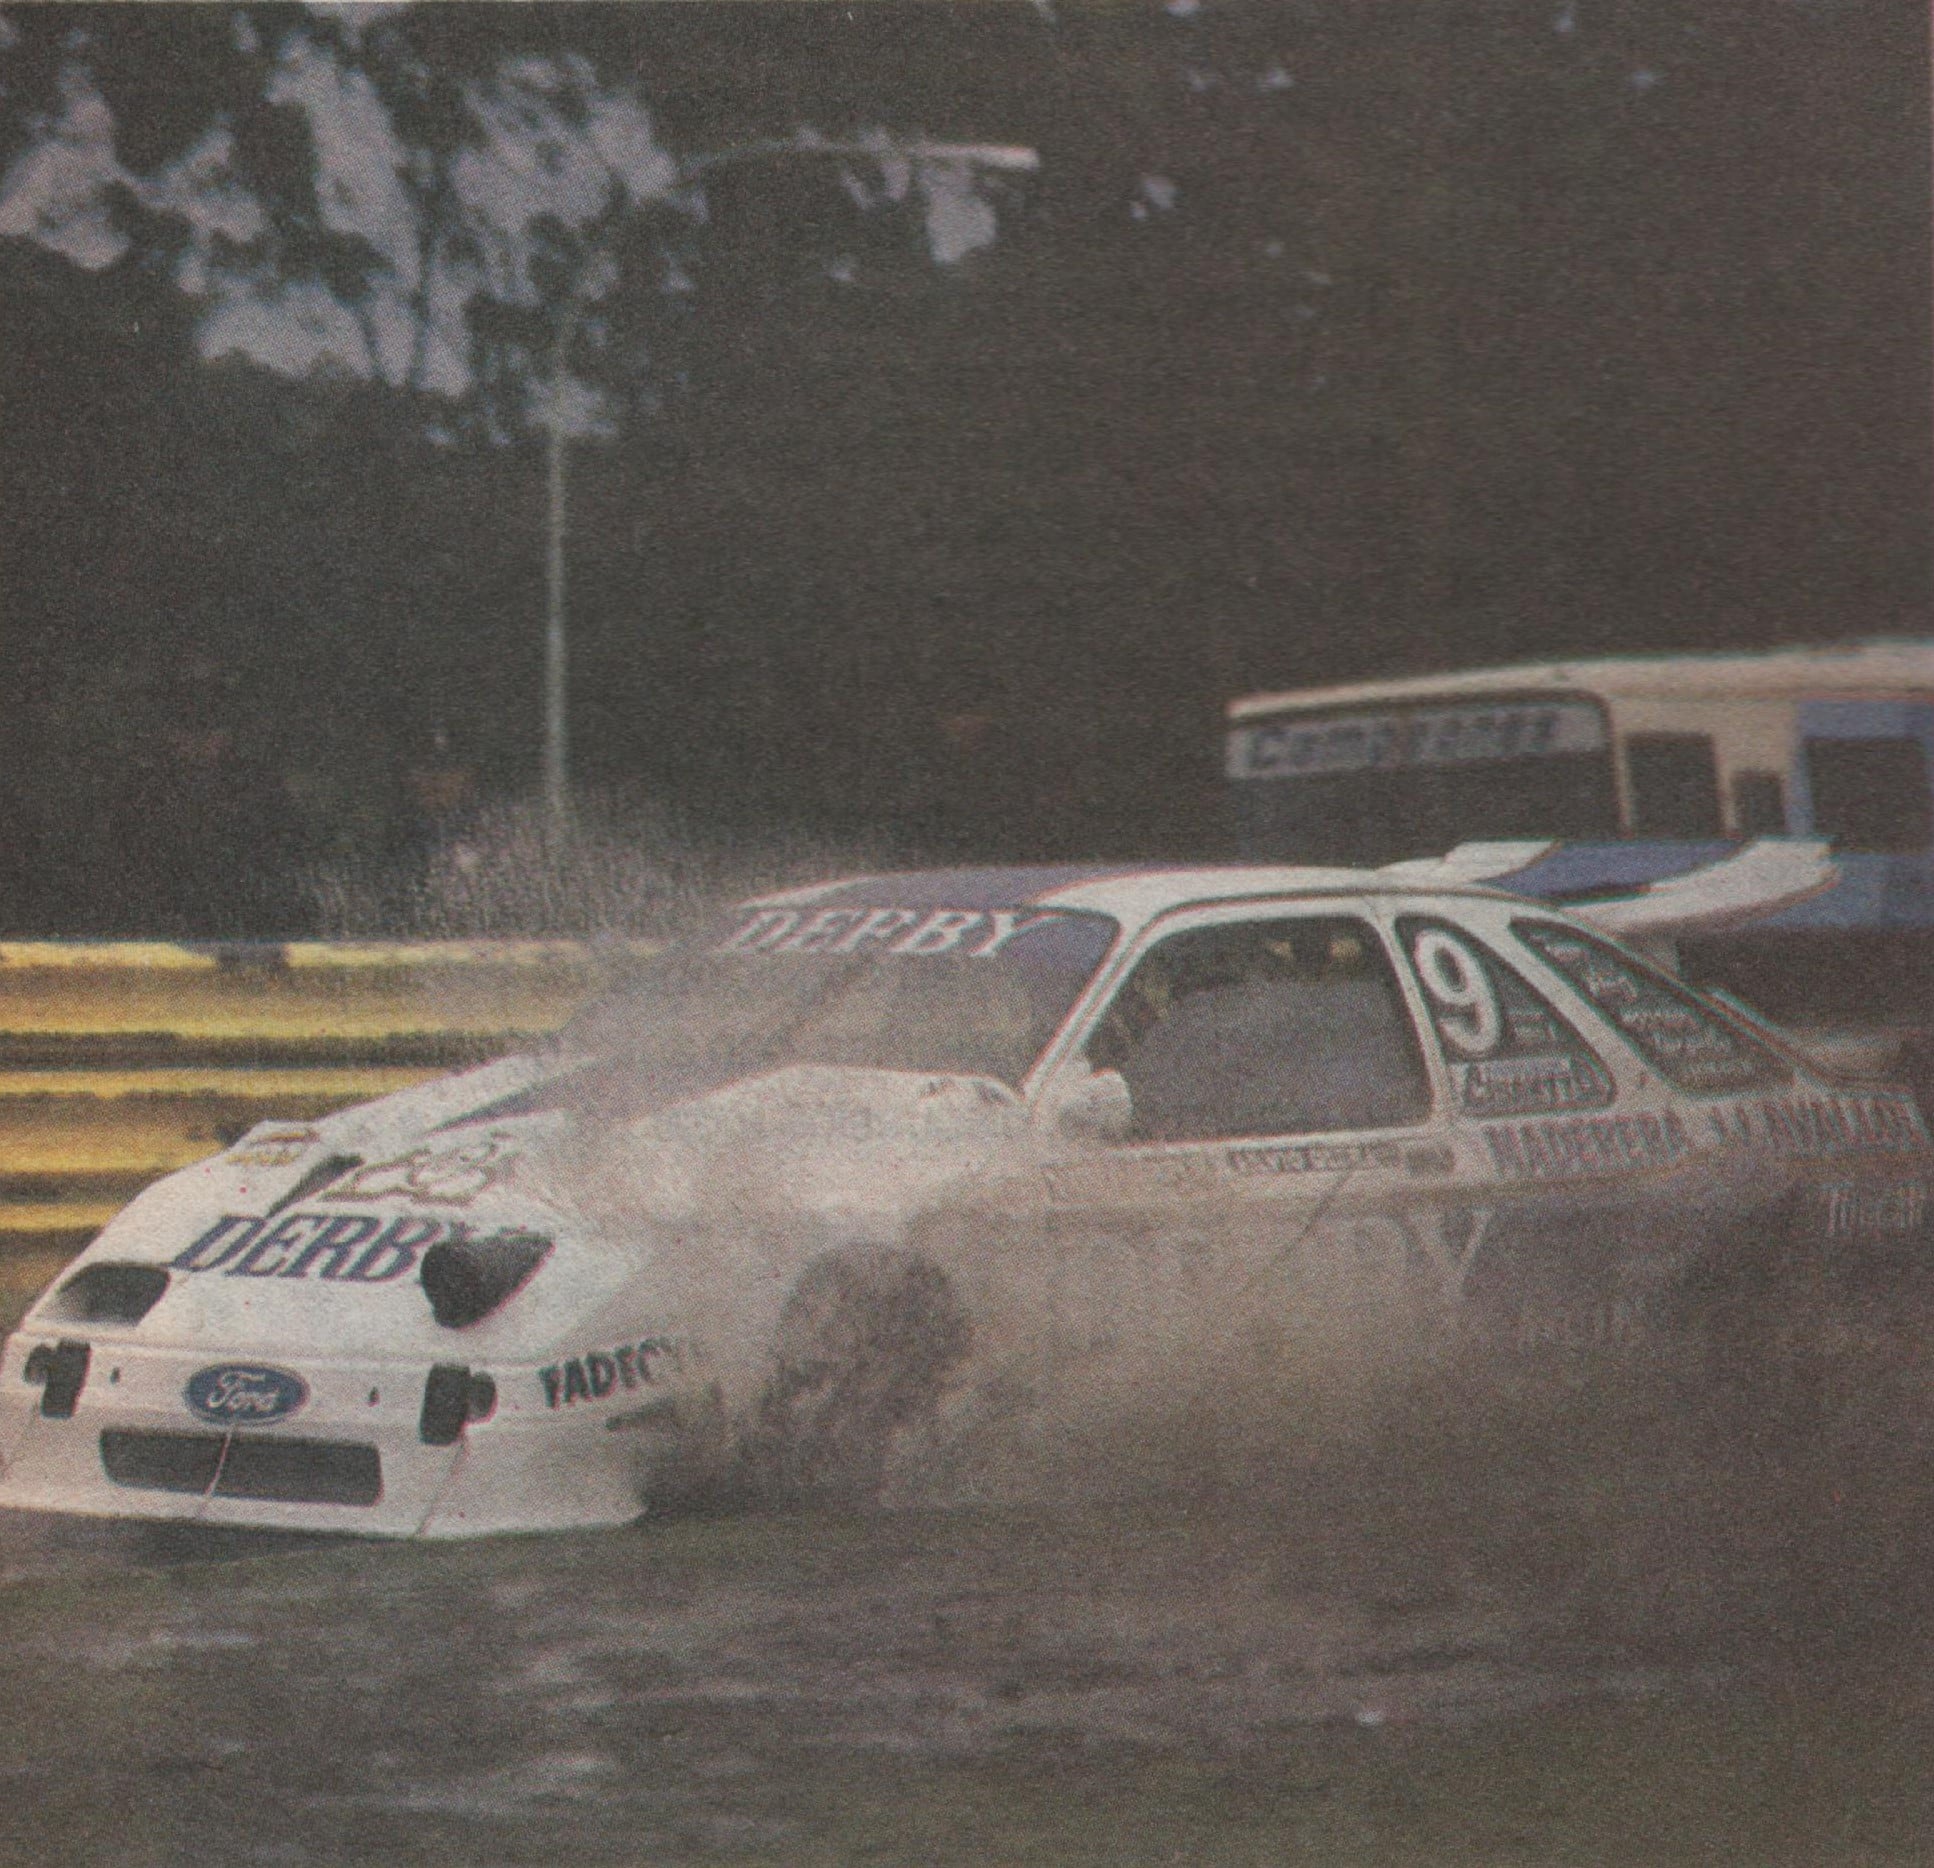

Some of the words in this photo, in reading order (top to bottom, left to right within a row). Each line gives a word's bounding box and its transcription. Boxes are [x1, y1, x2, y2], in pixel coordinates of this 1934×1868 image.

[724, 906, 1068, 957] DERBY
[1414, 930, 1498, 1055] 9
[168, 1211, 477, 1283] DERB
[206, 1370, 280, 1411] Ford
[540, 1337, 682, 1408] FADEC
